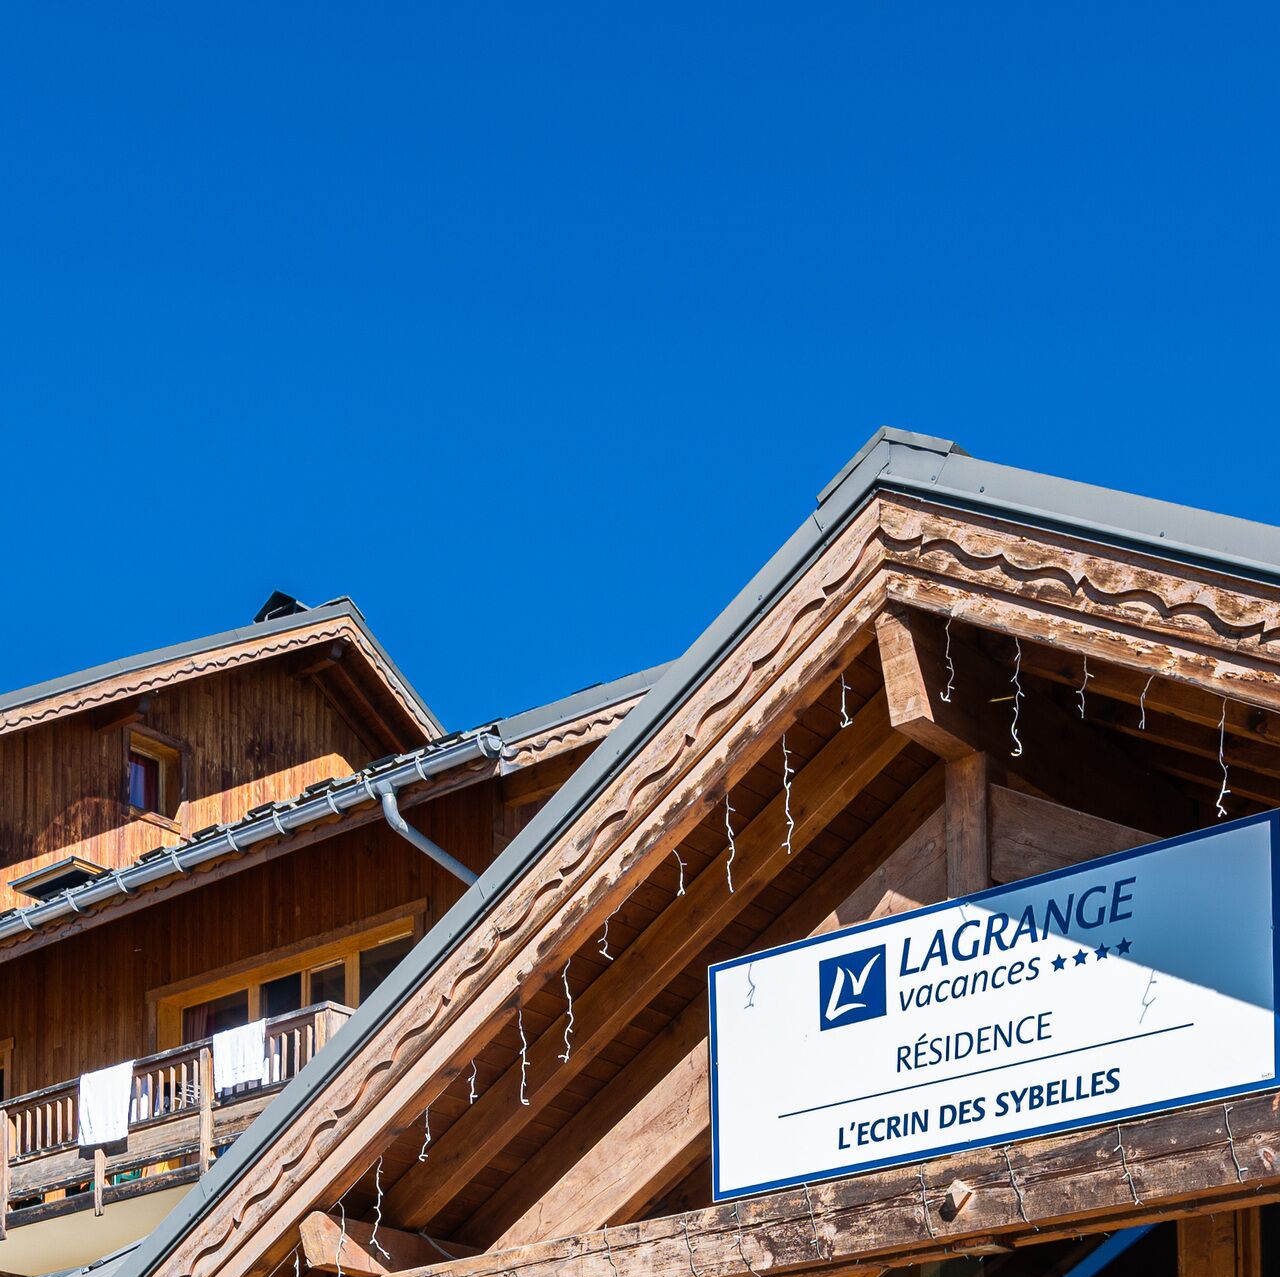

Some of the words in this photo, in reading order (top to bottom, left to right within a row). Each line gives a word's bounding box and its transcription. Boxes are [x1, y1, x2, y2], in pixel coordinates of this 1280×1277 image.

[899, 876, 1137, 977] LAGRANGE
[899, 956, 1041, 1012] vacances
[896, 1011, 1053, 1073] RÉSIDENCE
[939, 1096, 987, 1129] DES
[994, 1067, 1121, 1118] SYBELLES
